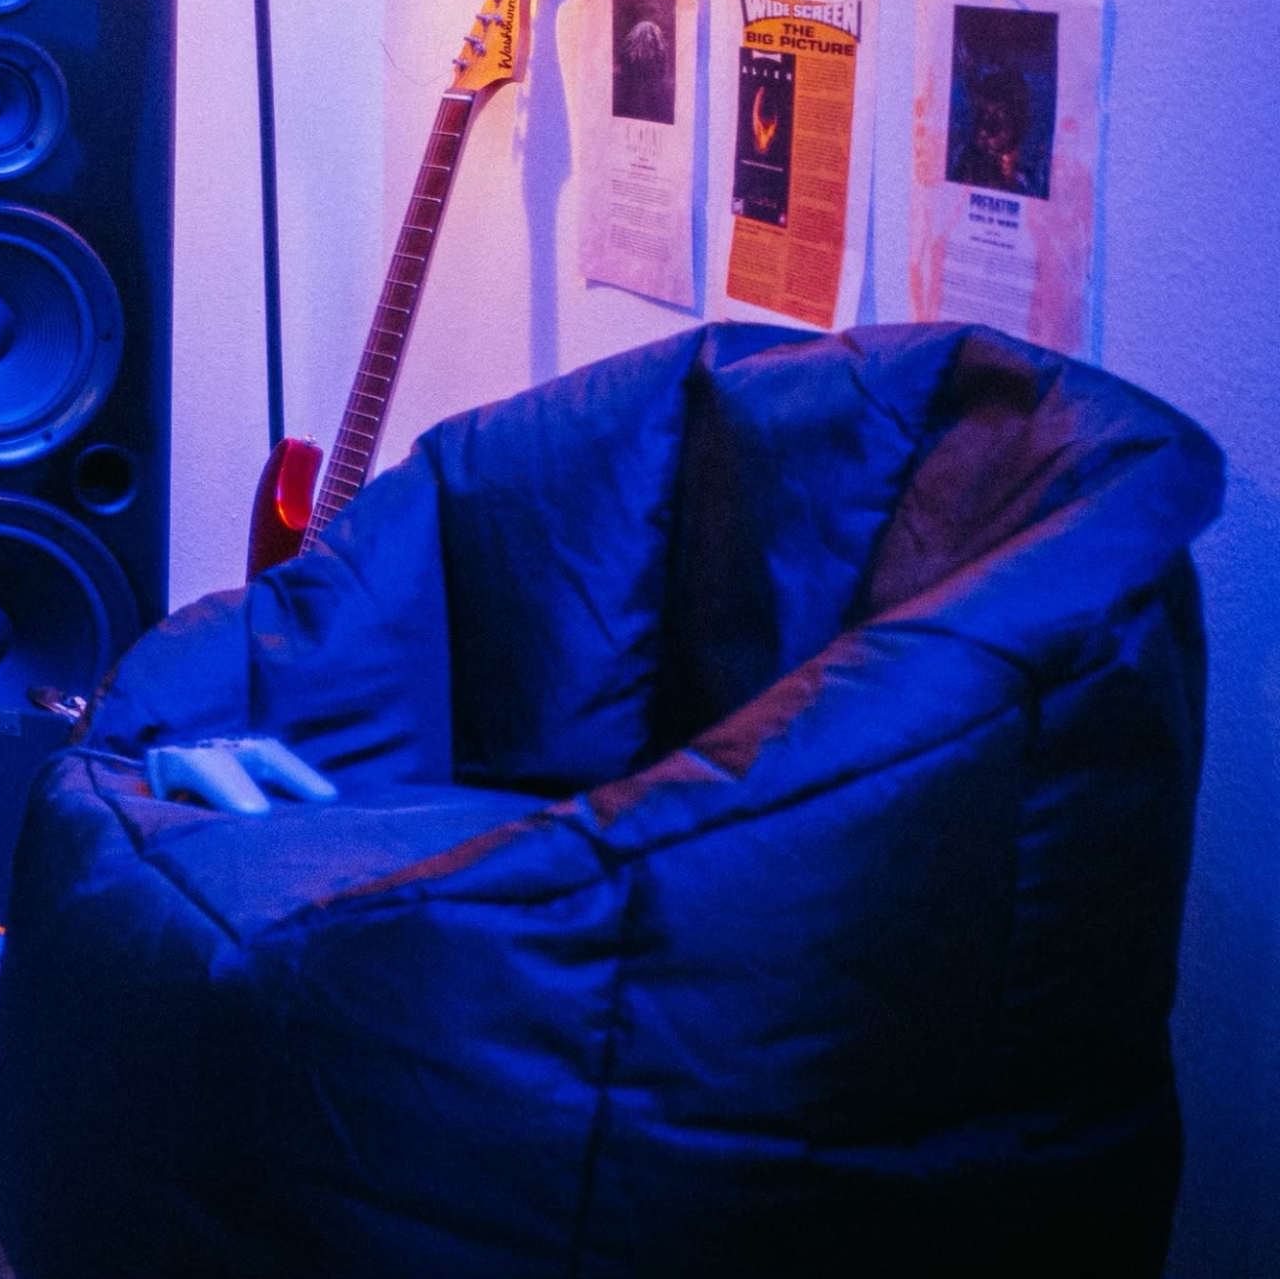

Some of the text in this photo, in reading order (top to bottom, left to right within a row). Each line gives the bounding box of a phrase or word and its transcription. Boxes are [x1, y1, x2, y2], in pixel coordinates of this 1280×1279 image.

[781, 23, 815, 38] THE
[793, 0, 859, 40] SCREEN
[745, 31, 857, 57] BIG PICTURE
[742, 65, 793, 81] ALIEN
